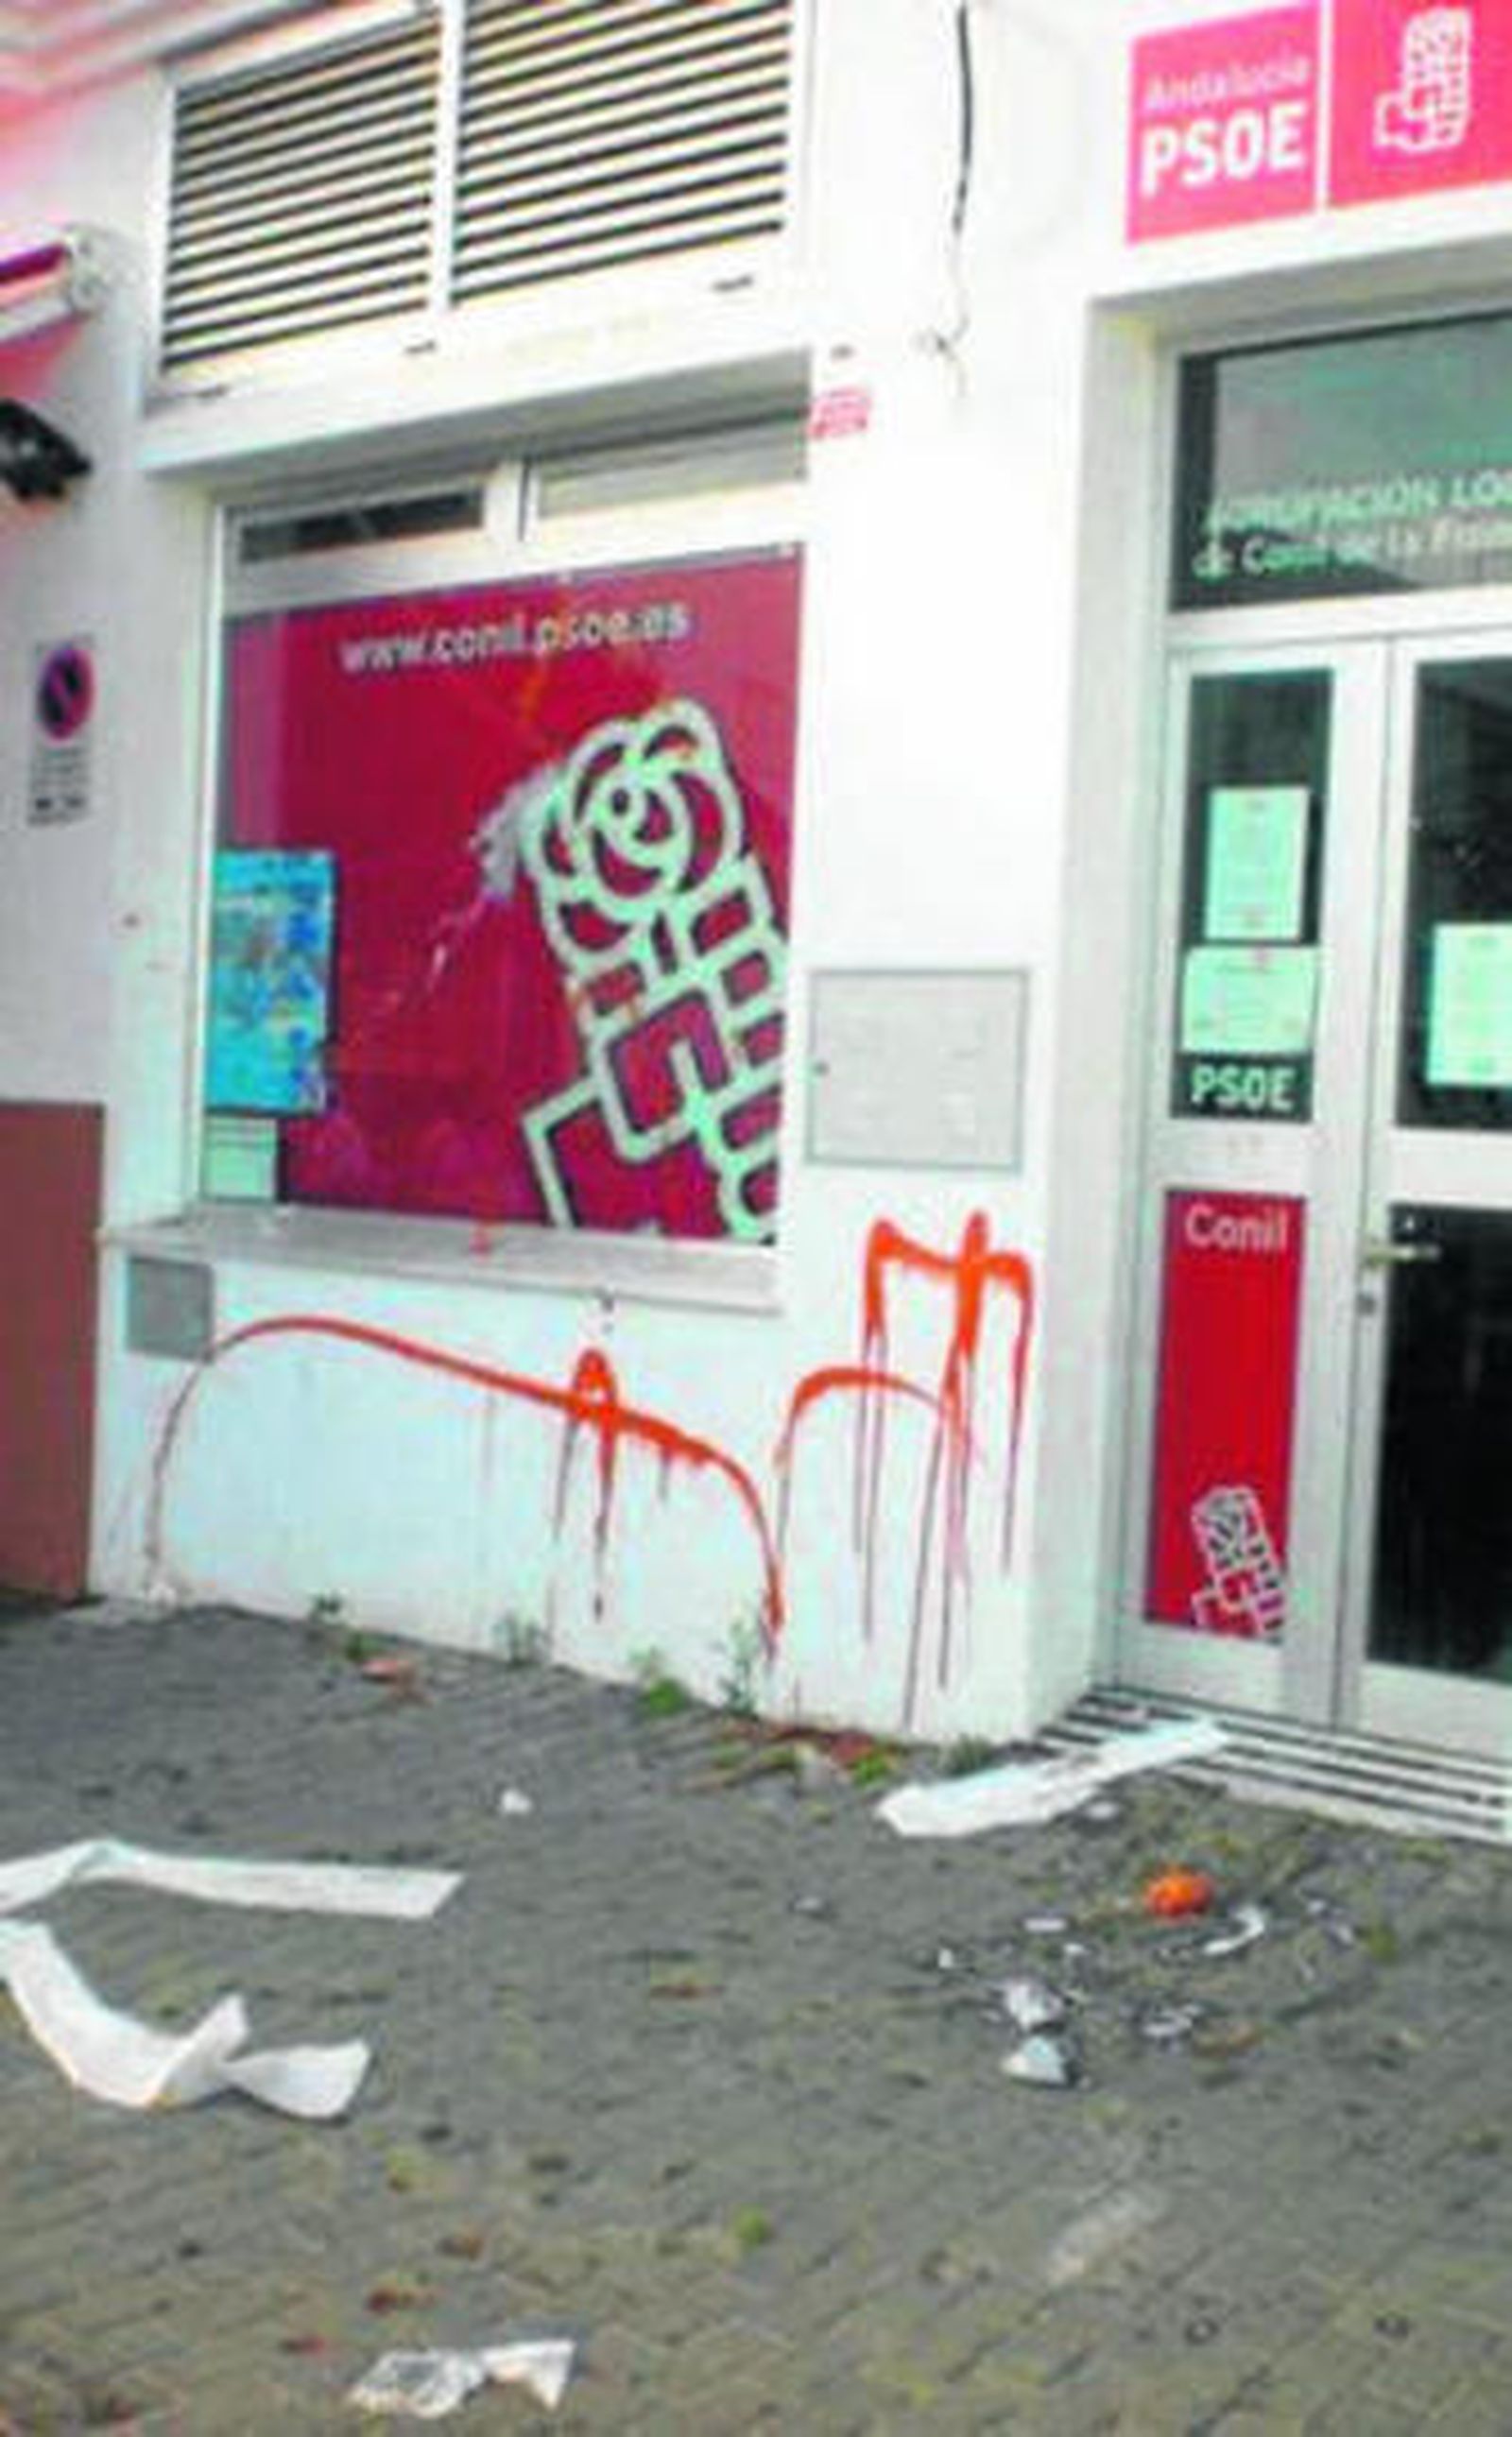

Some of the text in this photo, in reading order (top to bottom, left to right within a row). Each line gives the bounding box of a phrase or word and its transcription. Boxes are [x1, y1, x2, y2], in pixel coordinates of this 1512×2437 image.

[1141, 100, 1308, 199] PSOE
[1191, 1063, 1298, 1111] PSOE
[1186, 1202, 1288, 1254] Conil
